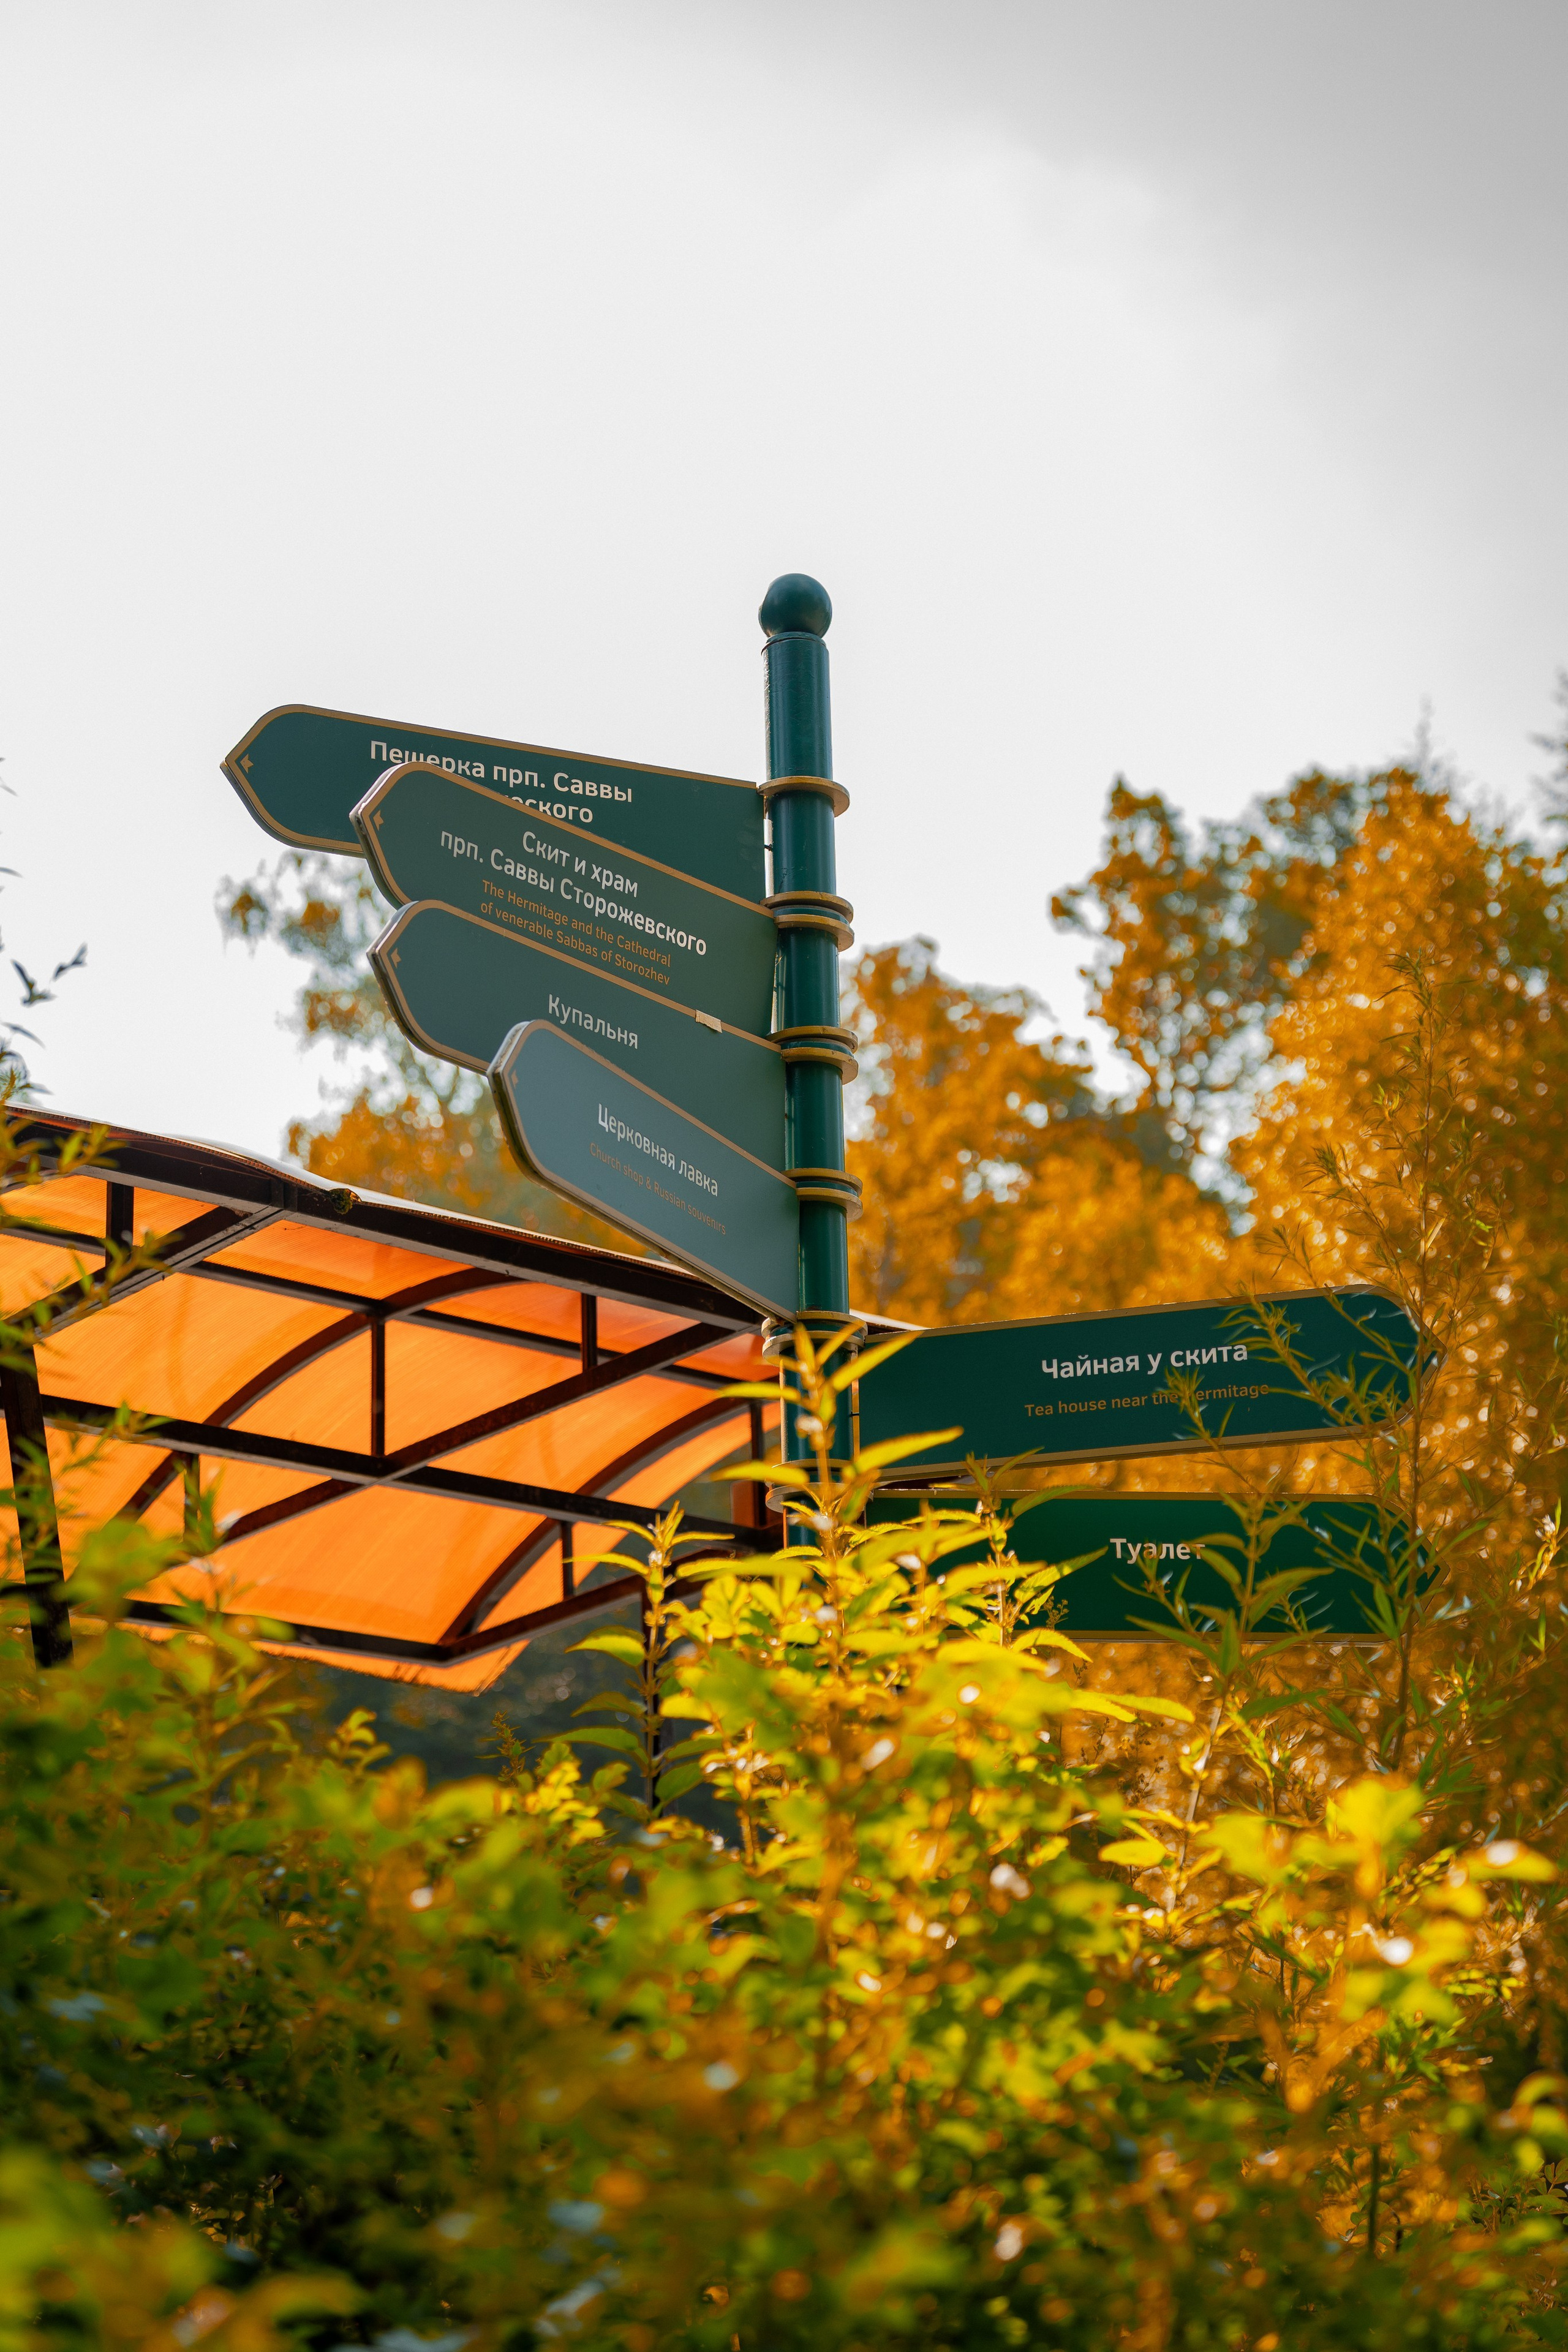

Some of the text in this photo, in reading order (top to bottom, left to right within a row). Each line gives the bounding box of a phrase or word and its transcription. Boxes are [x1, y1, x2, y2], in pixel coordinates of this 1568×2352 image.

[493, 765, 546, 788] прп.
[553, 772, 632, 803] Саввы
[440, 831, 707, 956] прп. Саввы Сторожевского
[522, 831, 638, 898] Скит и храм
[480, 902, 670, 986] of venerable Sabbas of Storozhev
[482, 880, 671, 968] The Hermitage and the Cathedral
[548, 993, 638, 1050] Купальня
[598, 1103, 718, 1197] Церковная лавка
[589, 1142, 726, 1235] Church shop & Russian souvenirs
[1041, 1343, 1248, 1379] Чайная у скита
[1025, 1384, 1270, 1417] Tea house near the ermitage
[1110, 1538, 1205, 1565] Туалет
